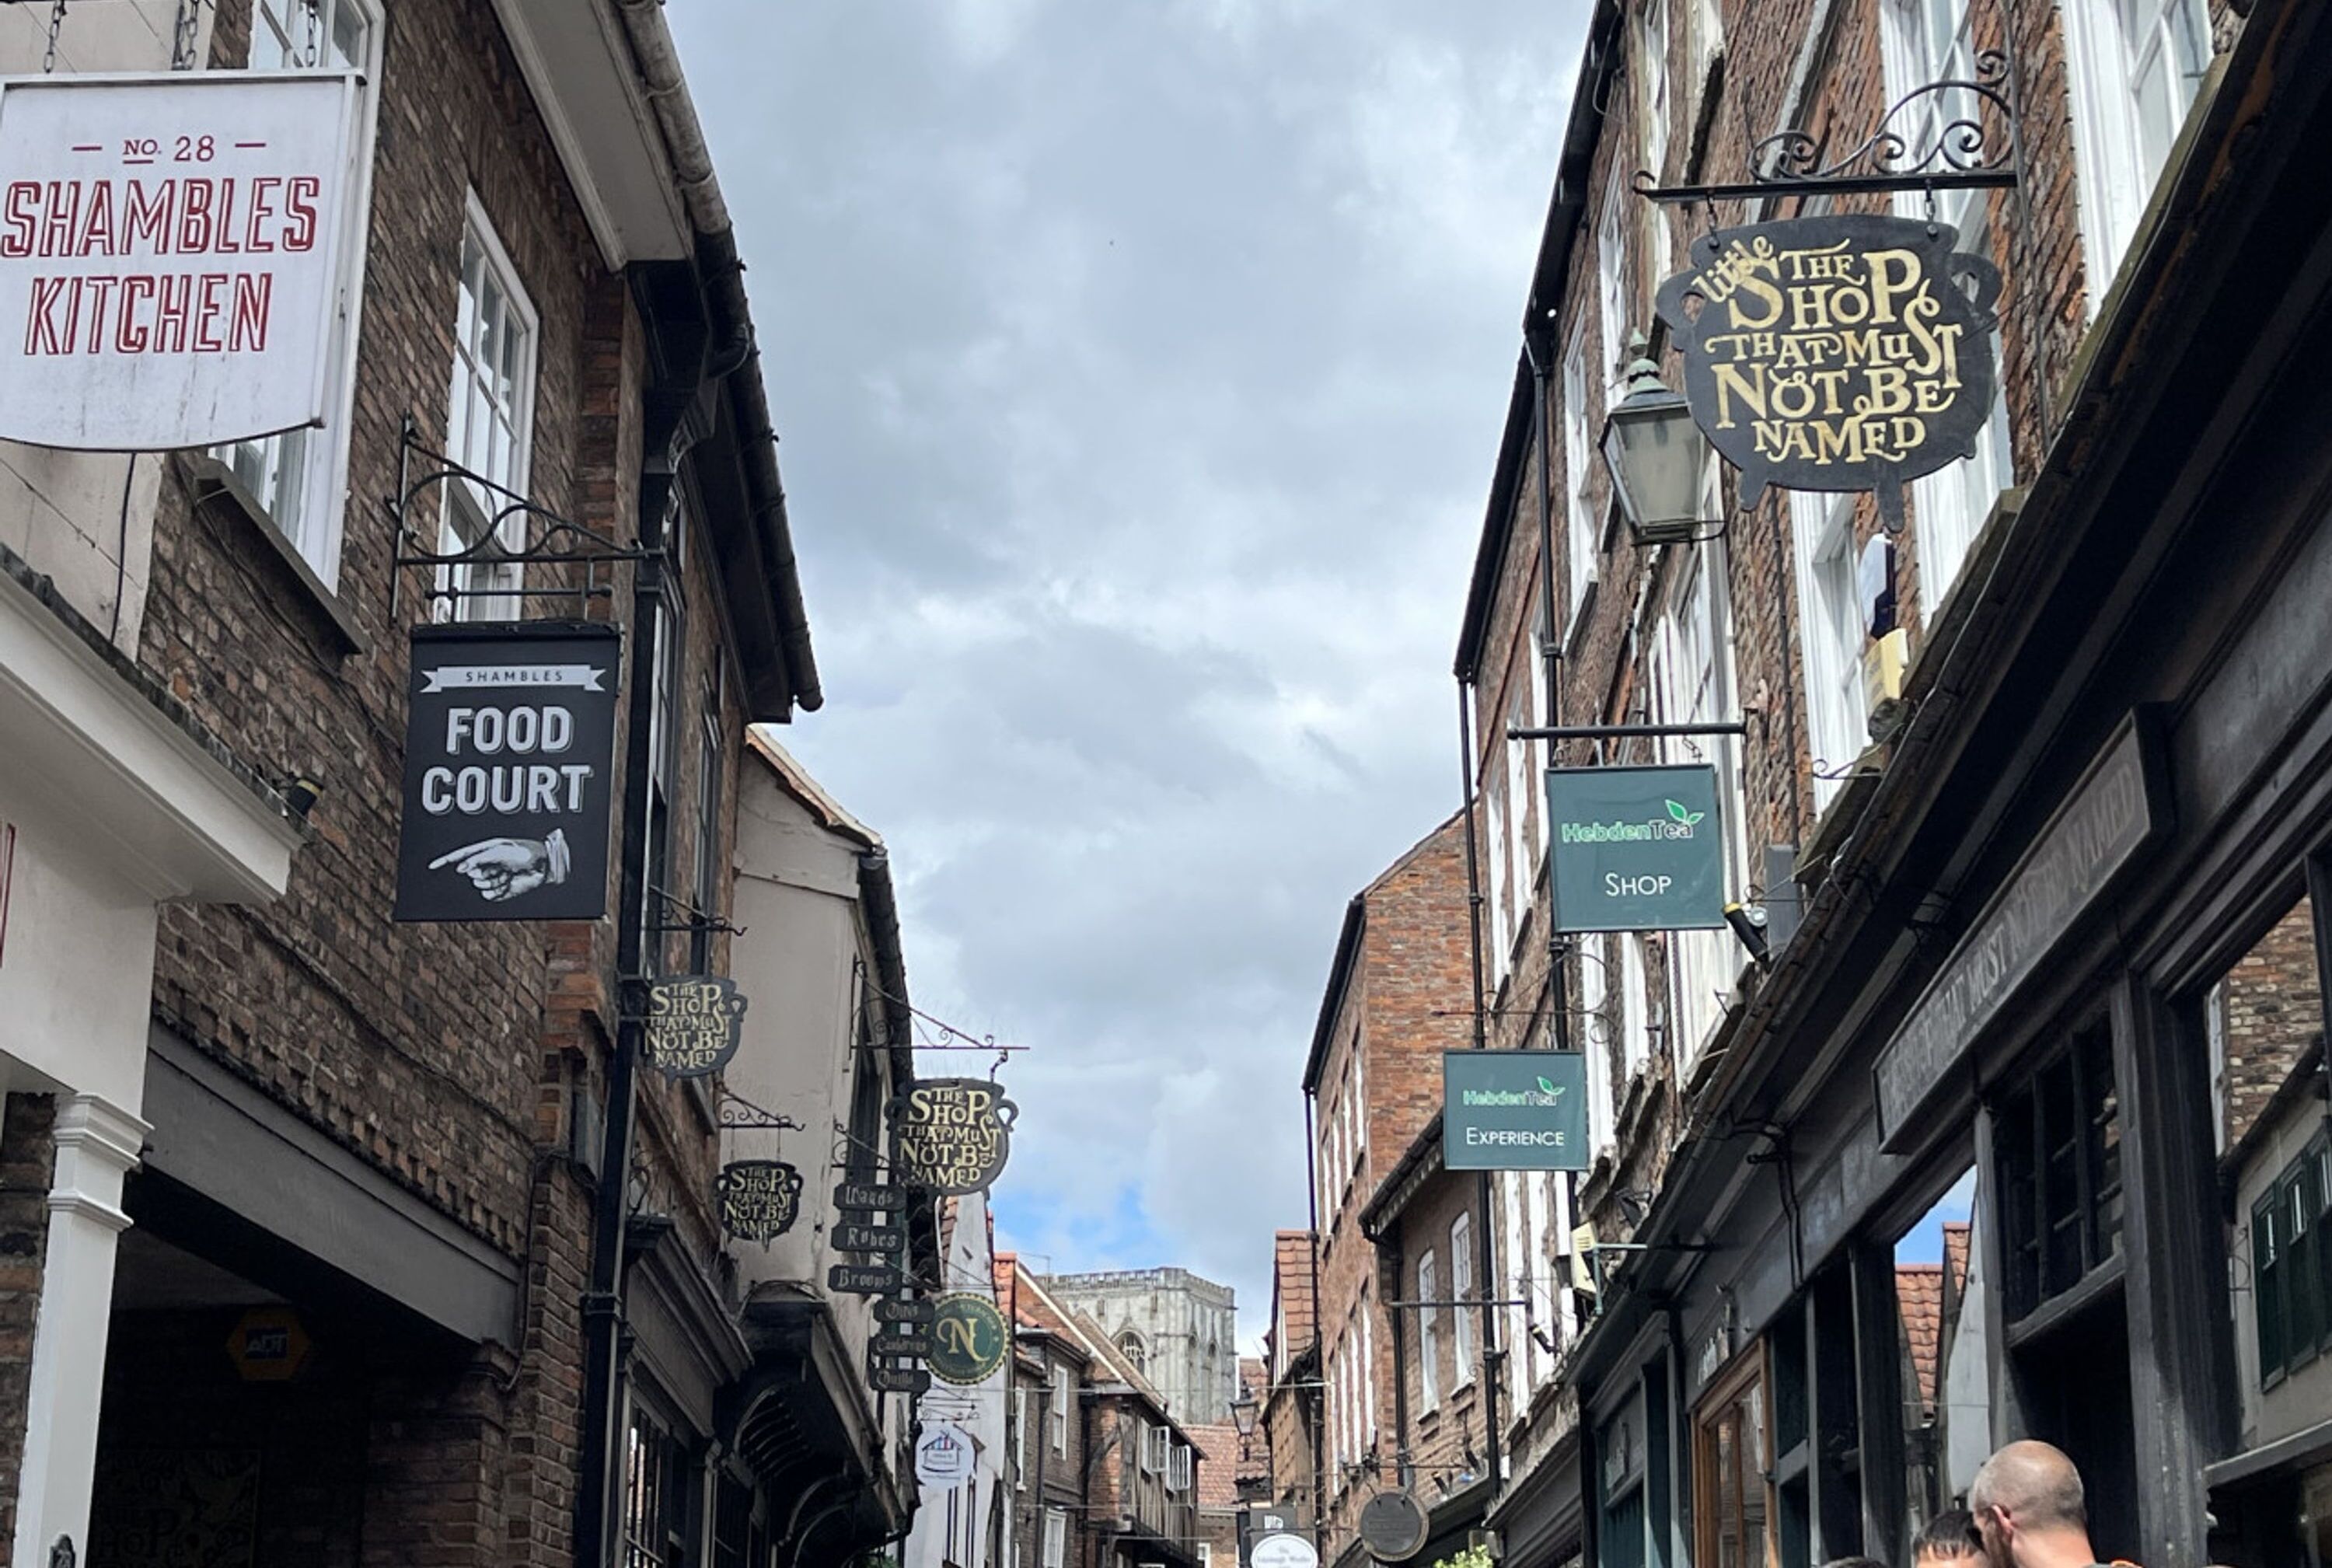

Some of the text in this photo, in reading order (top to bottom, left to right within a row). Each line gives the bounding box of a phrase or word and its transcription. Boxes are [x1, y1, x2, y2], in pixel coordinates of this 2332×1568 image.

[123, 136, 215, 162] NO. 28
[1, 176, 320, 257] SHAMBLES
[1692, 235, 1775, 303] little
[1779, 239, 1866, 285] THE
[1729, 249, 1922, 330] SHOP
[24, 273, 272, 355] KITCHEN
[1705, 329, 1842, 370] THAT
[1711, 362, 1956, 429] NOT BE
[1752, 417, 1927, 465] NAMED
[466, 670, 564, 682] SHAMBLES
[446, 706, 574, 754] FOOD
[422, 765, 593, 815] COURT
[1605, 871, 1672, 897] SHOP
[650, 985, 722, 1015] SHOP
[669, 980, 698, 997] THE
[645, 1028, 728, 1054] NOT BE
[655, 1050, 717, 1070] NAMED
[908, 1089, 990, 1125] SHOP
[931, 1085, 967, 1105] THE
[1466, 1127, 1565, 1146] EXPERIENCE
[899, 1138, 995, 1167] NOT BE
[730, 1168, 786, 1192] SHOP
[911, 1165, 981, 1188] NAMED
[724, 1200, 760, 1221] NOT
[837, 1269, 893, 1287] Brooms
[936, 1318, 990, 1362] N
